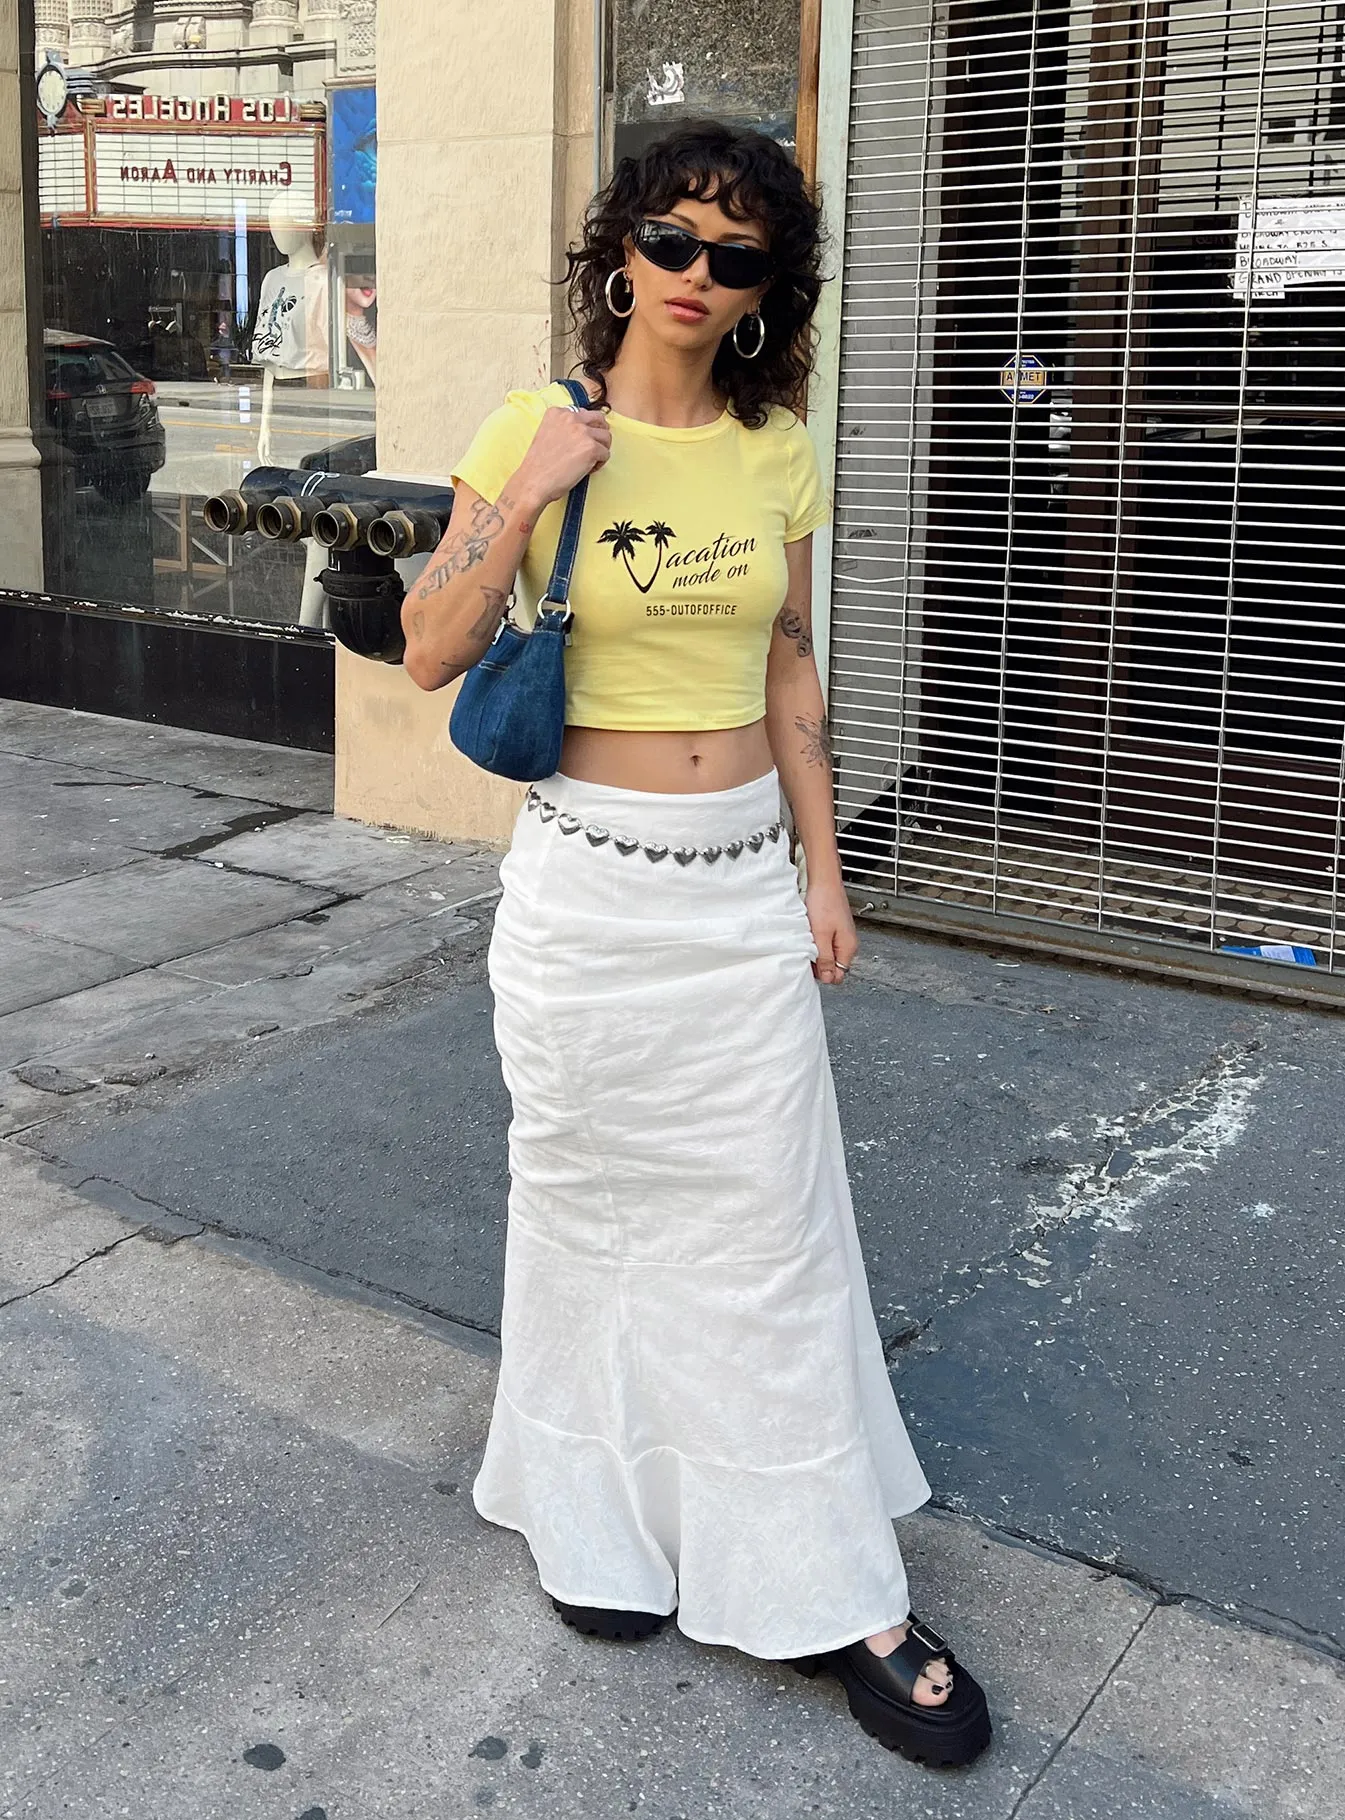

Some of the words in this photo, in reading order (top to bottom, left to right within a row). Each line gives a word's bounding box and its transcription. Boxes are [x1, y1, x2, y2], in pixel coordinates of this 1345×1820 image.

[672, 561, 721, 589] mode
[727, 563, 750, 578] on
[646, 604, 738, 617] 555-OUTOFOFFICE
